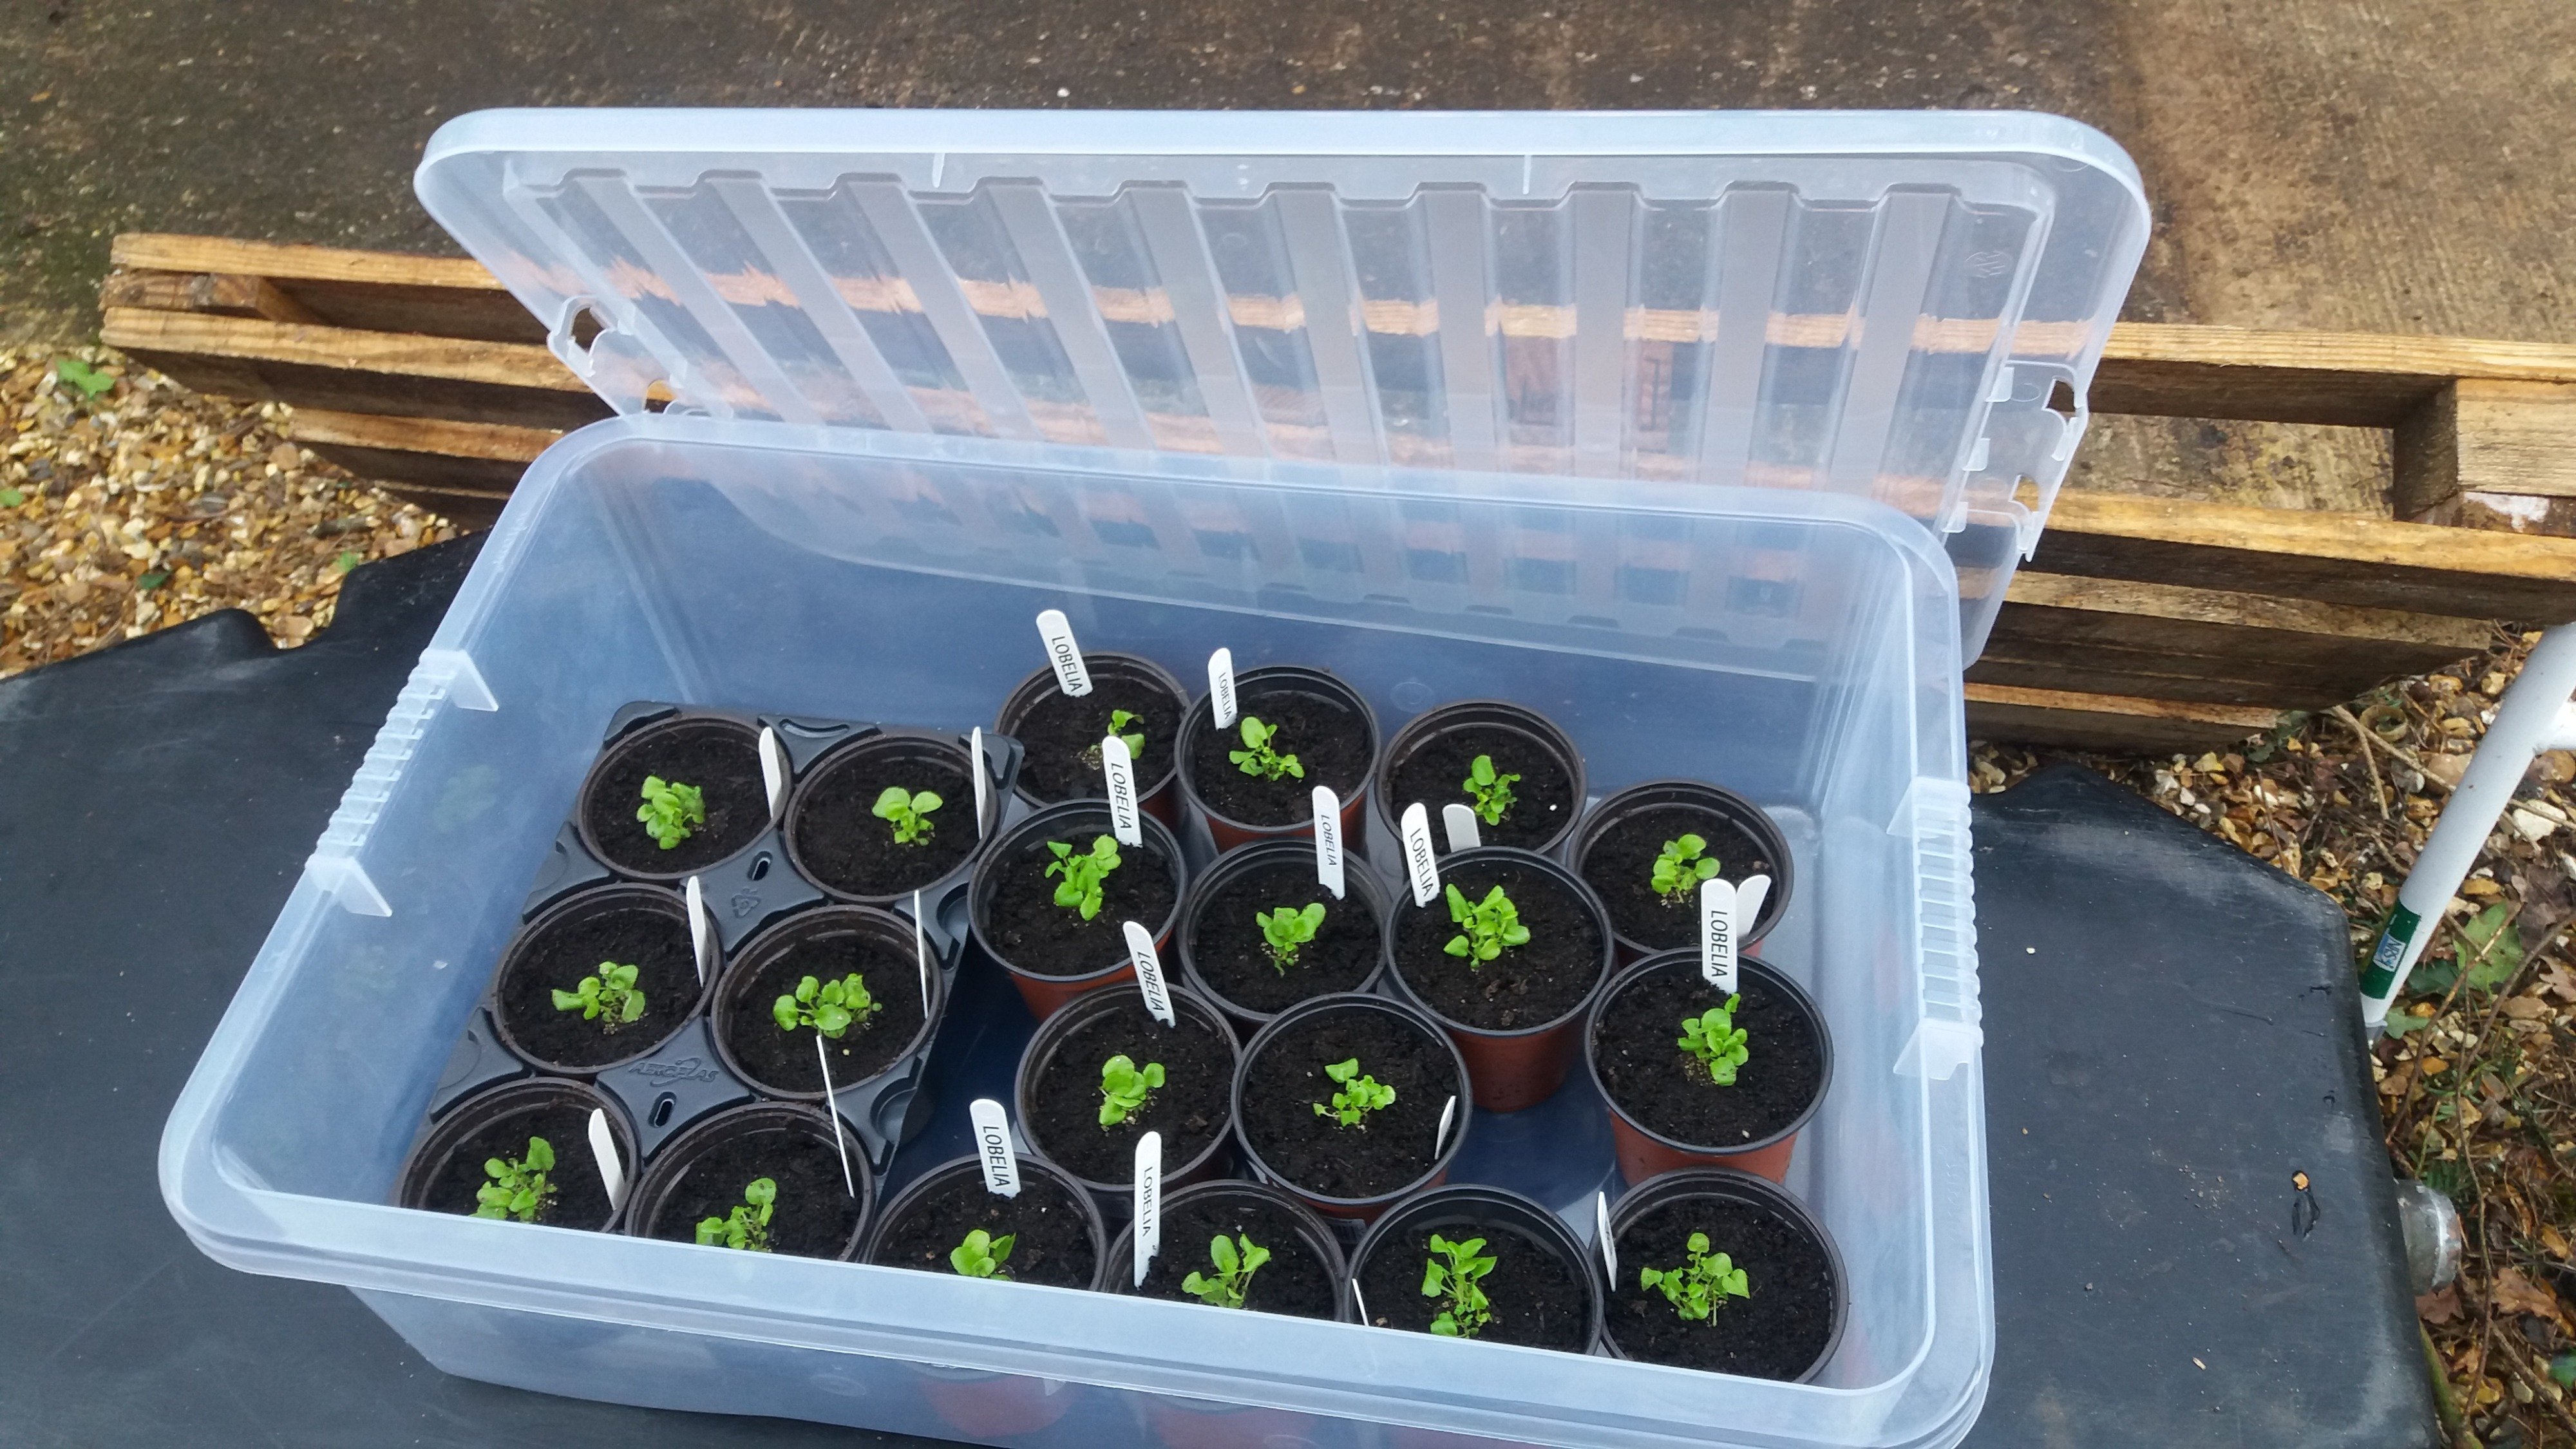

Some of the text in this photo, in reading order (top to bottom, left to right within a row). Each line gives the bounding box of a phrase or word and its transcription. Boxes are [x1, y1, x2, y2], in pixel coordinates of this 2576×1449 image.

[1051, 636, 1083, 692] LOBELIA
[1219, 672, 1231, 720] LOBELIA
[1111, 763, 1132, 829] LOBELIA
[1321, 814, 1337, 866] LOBELIA
[1410, 828, 1434, 896] LOBELIA
[1710, 910, 1728, 977] LOBELIA
[1137, 951, 1165, 1011] LOBELIA
[983, 1126, 1011, 1187] LOBELIA
[1143, 1166, 1153, 1236] LOBELIA
